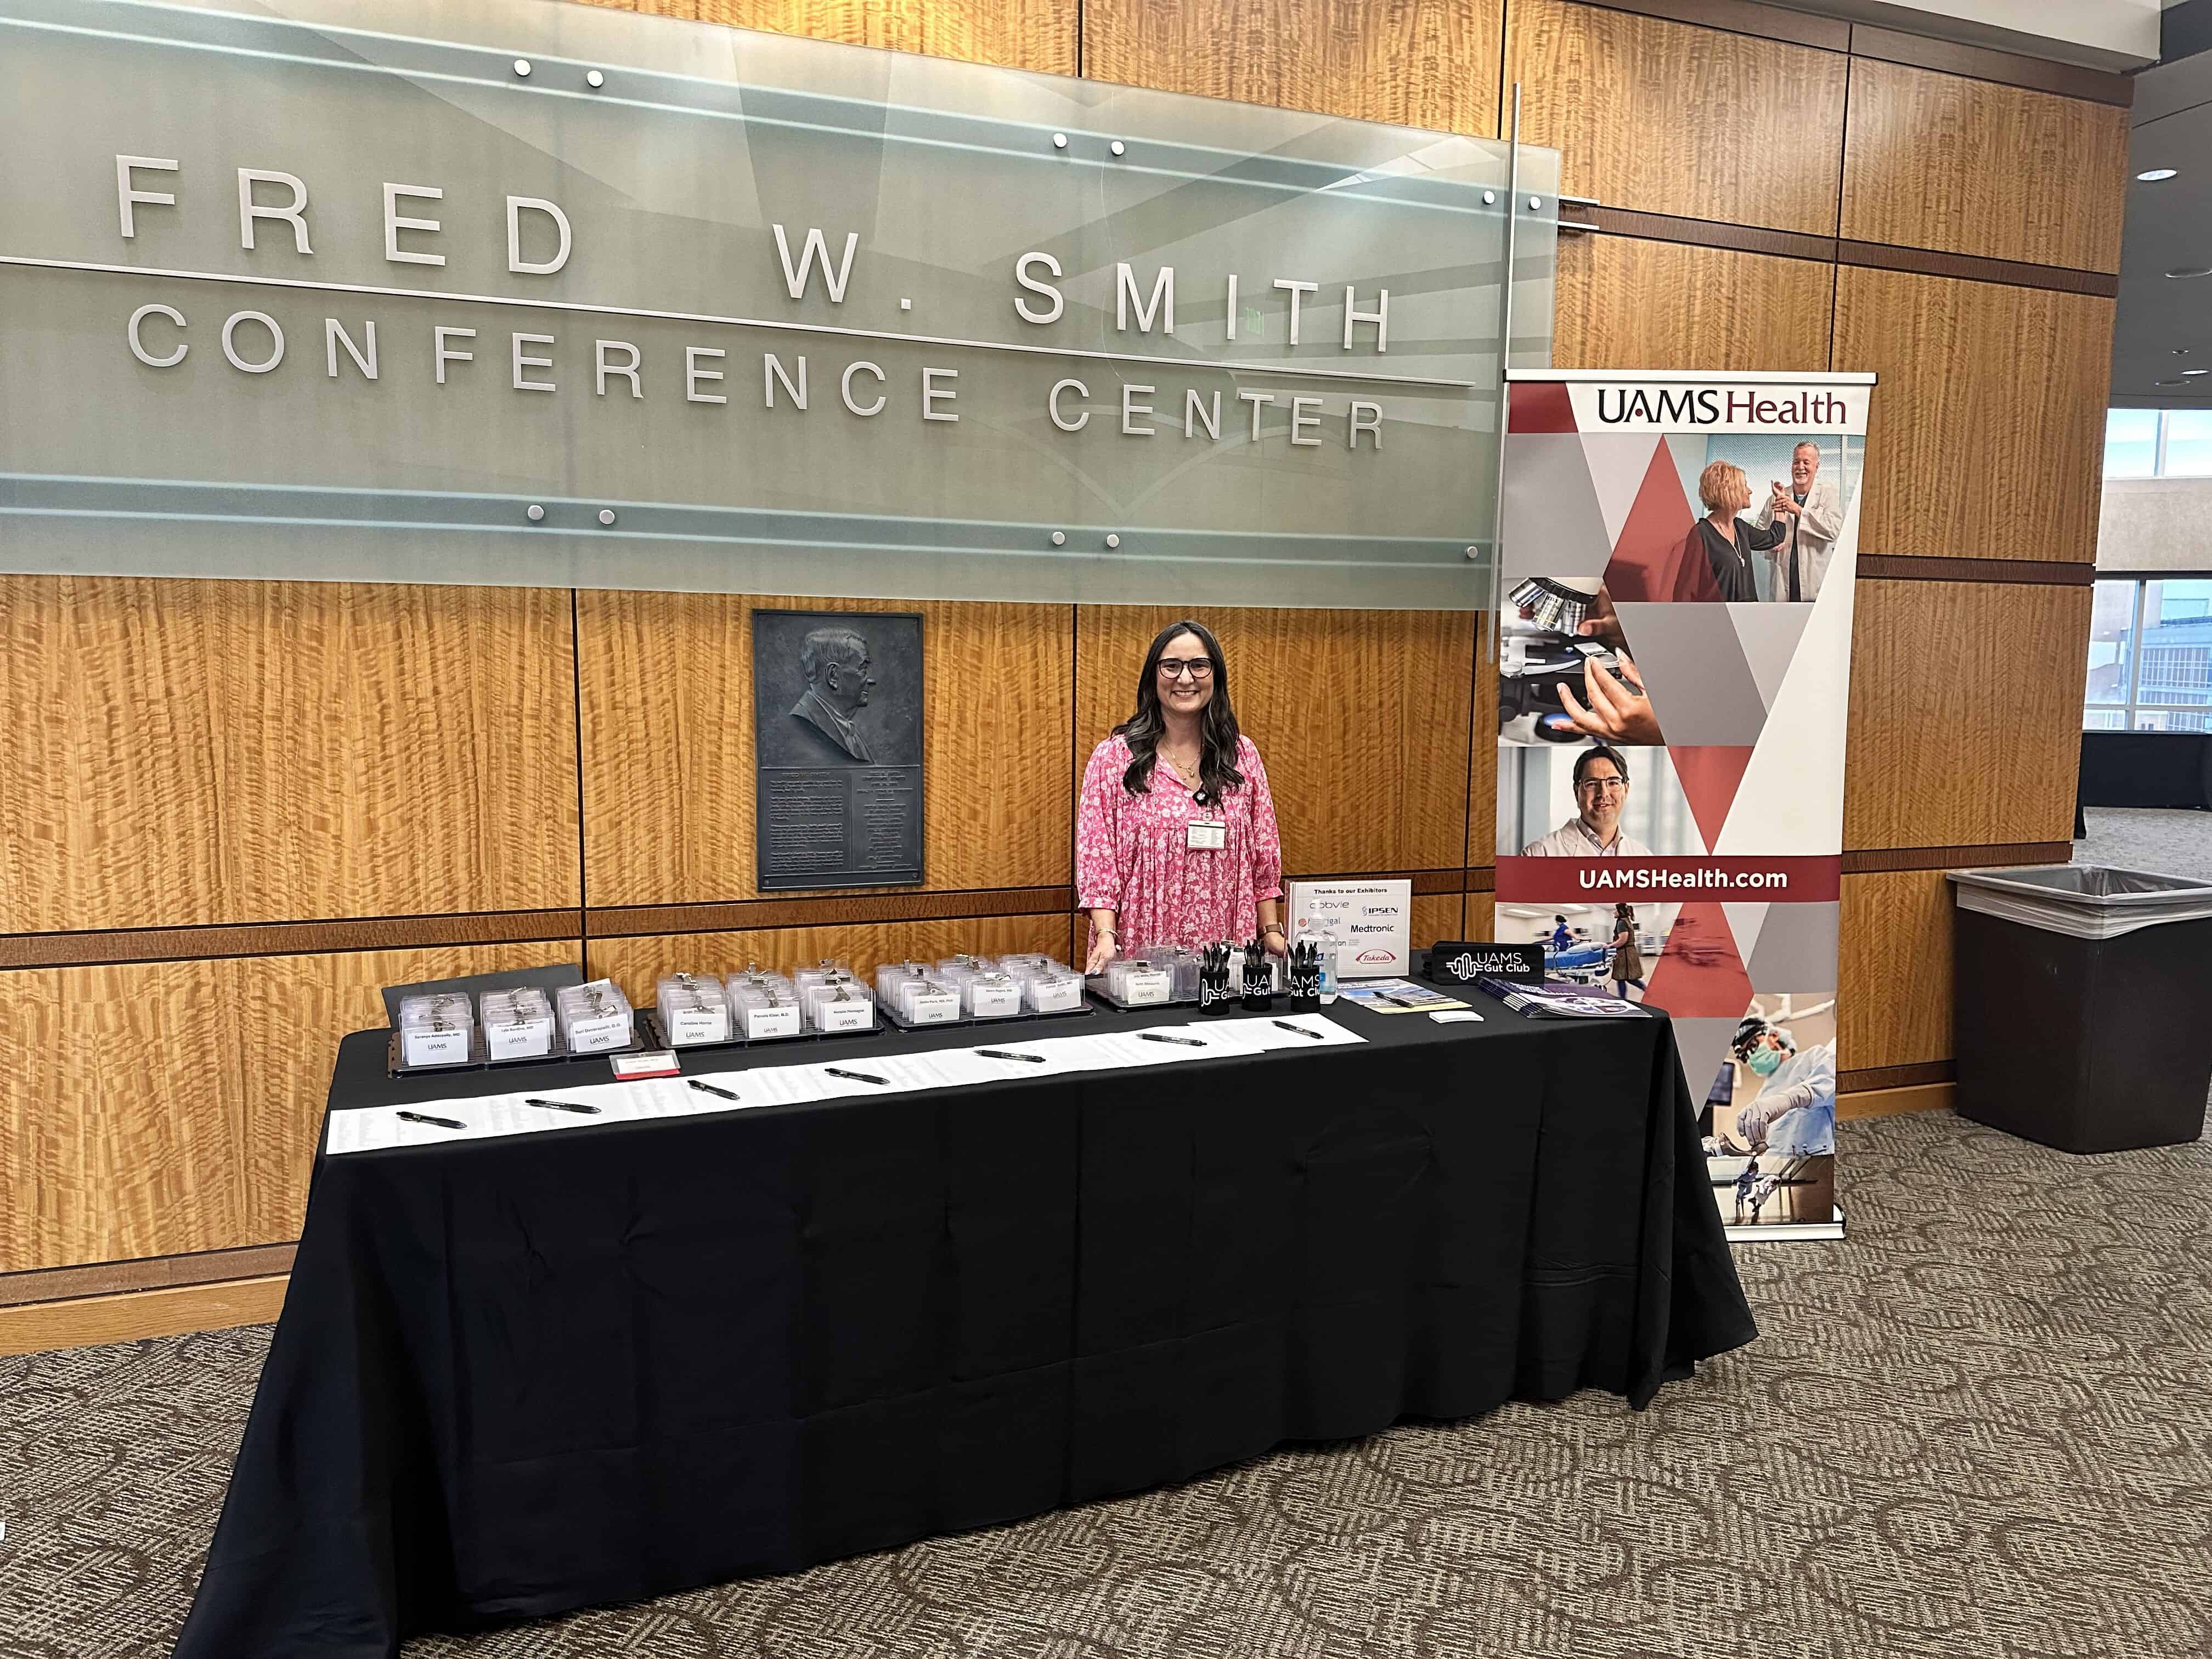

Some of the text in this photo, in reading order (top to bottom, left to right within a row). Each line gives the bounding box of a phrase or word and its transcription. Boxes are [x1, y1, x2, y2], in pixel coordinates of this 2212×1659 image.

[116, 154, 1389, 353] FRED W. SMITH
[127, 303, 1383, 450] CONFERENCE CENTER
[1597, 389, 1847, 425] UAMS Health
[1579, 868, 1788, 889] UAMSHealth.com
[1350, 924, 1395, 933] Medtronic
[1477, 952, 1522, 964] UAMS
[1484, 963, 1531, 972] Gut Club
[590, 1035, 610, 1044] UAMS
